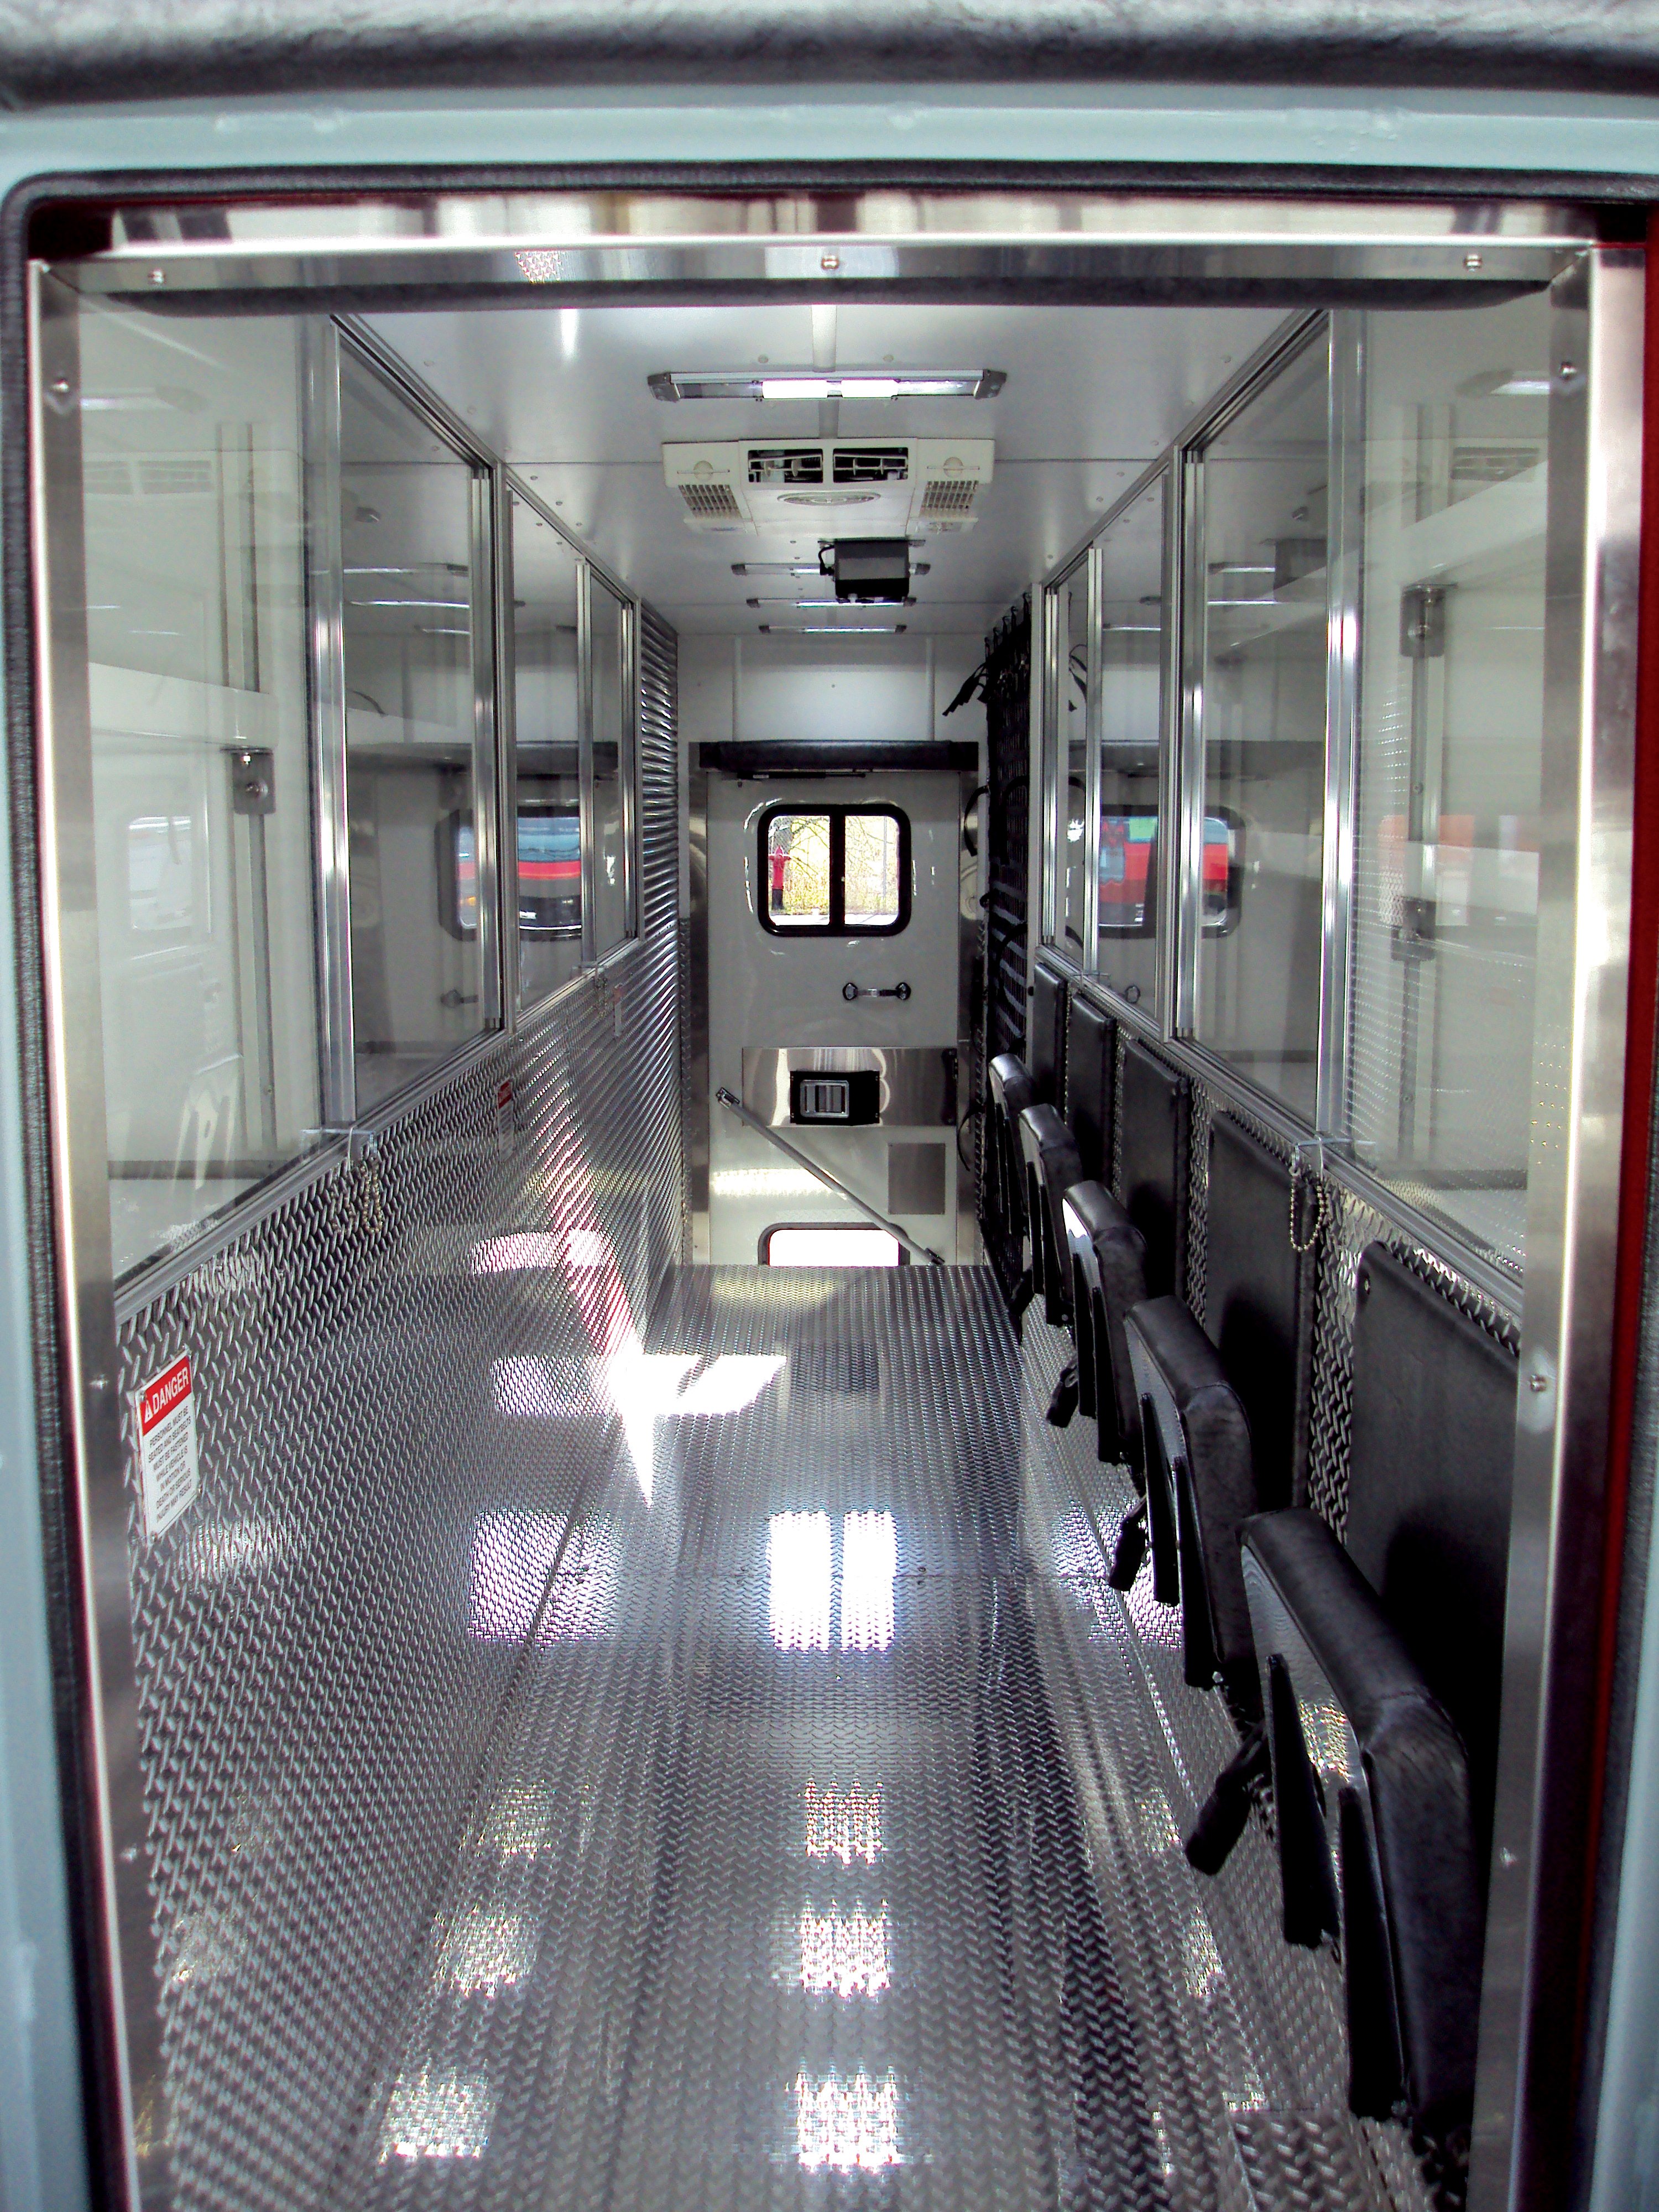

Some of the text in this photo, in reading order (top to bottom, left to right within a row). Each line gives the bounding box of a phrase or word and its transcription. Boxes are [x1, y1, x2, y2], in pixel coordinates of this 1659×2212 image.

[153, 1366, 189, 1415] DANGER
[149, 1443, 163, 1463] SEATED
[173, 1416, 191, 1440] SEATBELTS
[150, 1406, 188, 1448] PERSONNEL MUST BE
[154, 1431, 188, 1470] MUST BE FASTENED
[156, 1464, 168, 1481] WHILE
[169, 1449, 184, 1469] VEHICLE
[156, 1468, 190, 1509] DEATH OR SERIOUS
[160, 1460, 186, 1491] IN MOTION OR
[156, 1503, 170, 1522] INJURY
